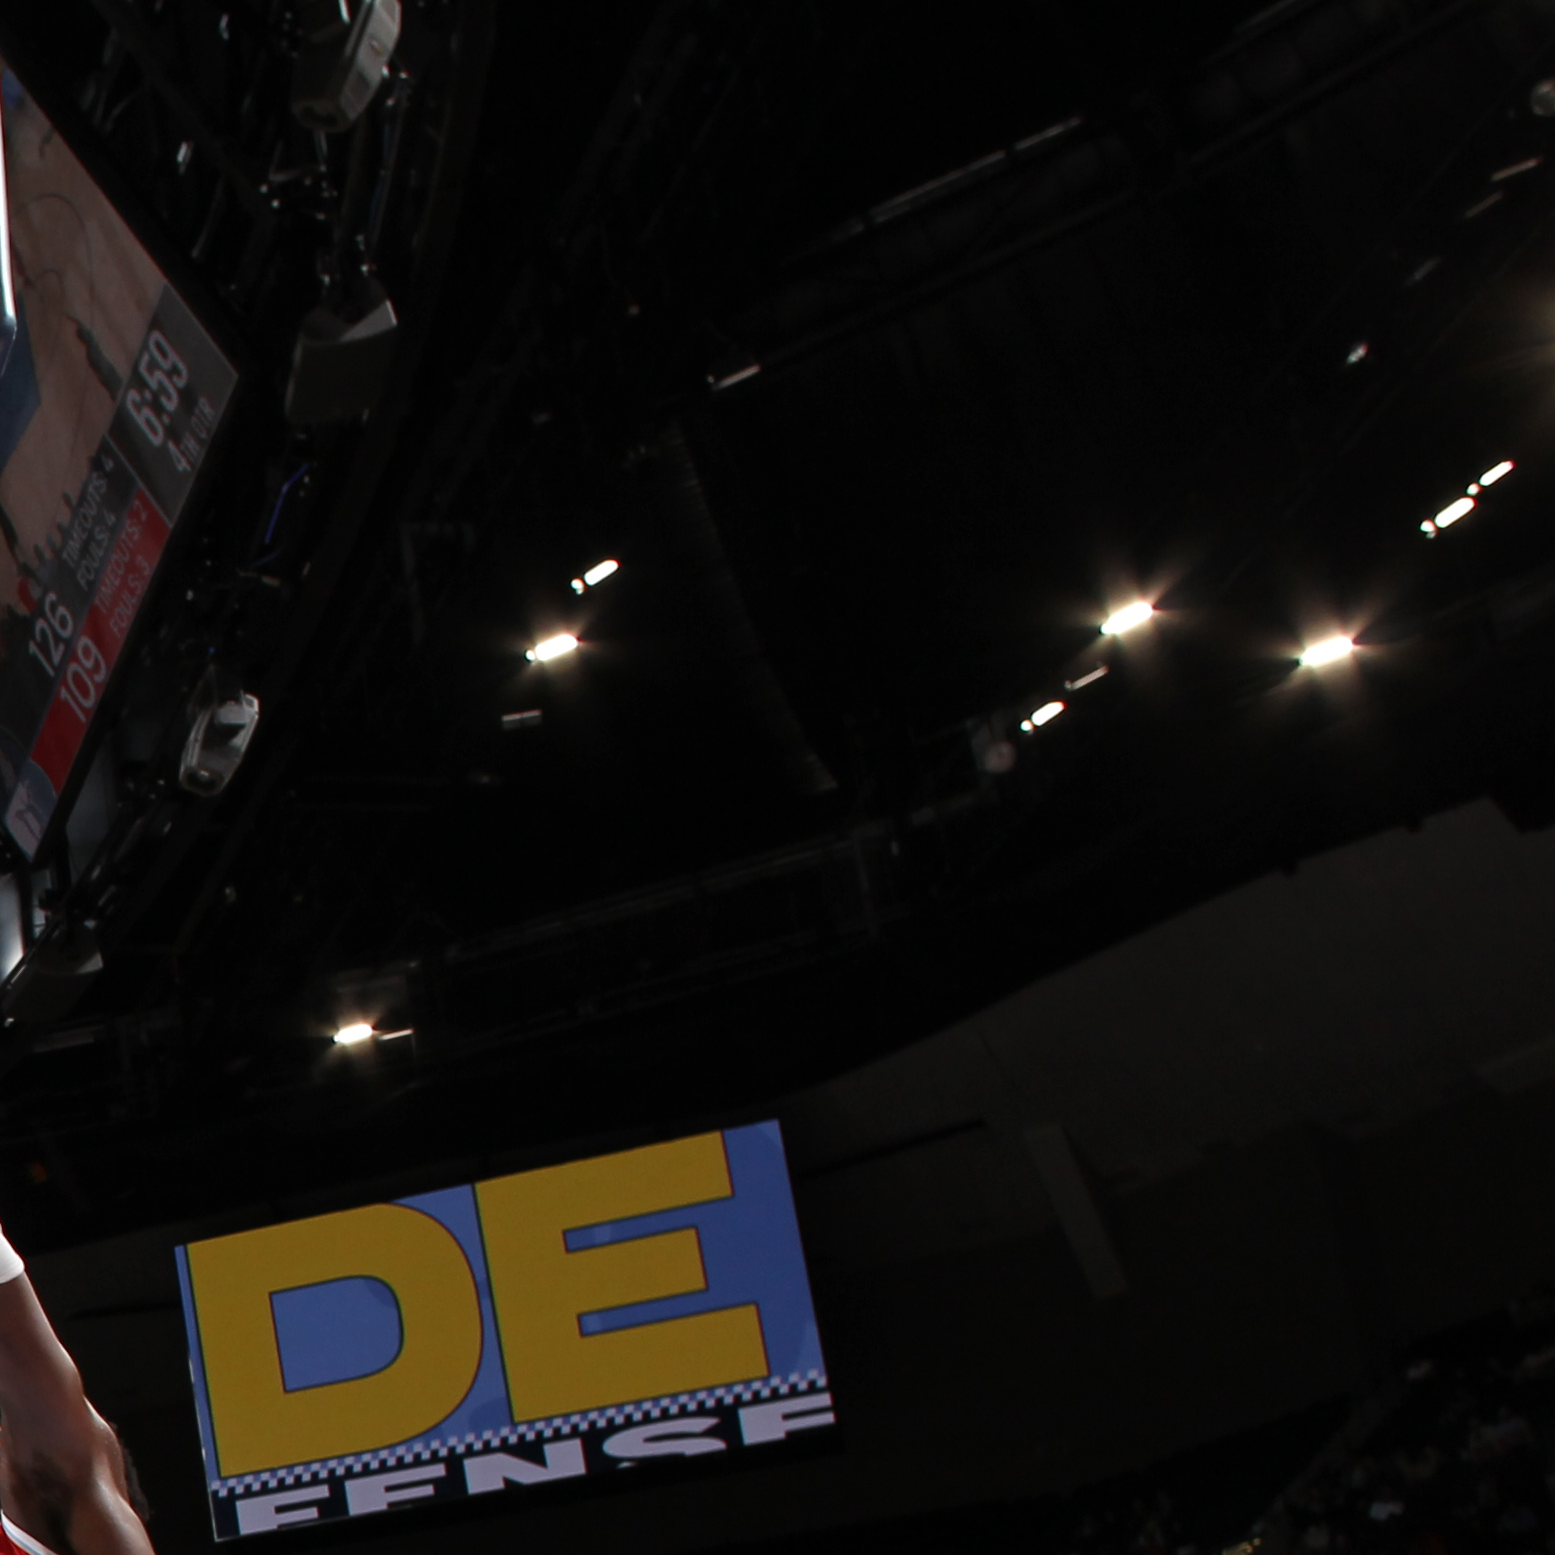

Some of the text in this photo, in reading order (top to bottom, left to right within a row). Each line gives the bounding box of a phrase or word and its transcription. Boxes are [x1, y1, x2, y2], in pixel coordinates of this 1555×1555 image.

[126, 329, 190, 446] 6:59
[29, 591, 74, 677] 126
[60, 636, 107, 723] 109
[186, 1130, 770, 1478] DE
